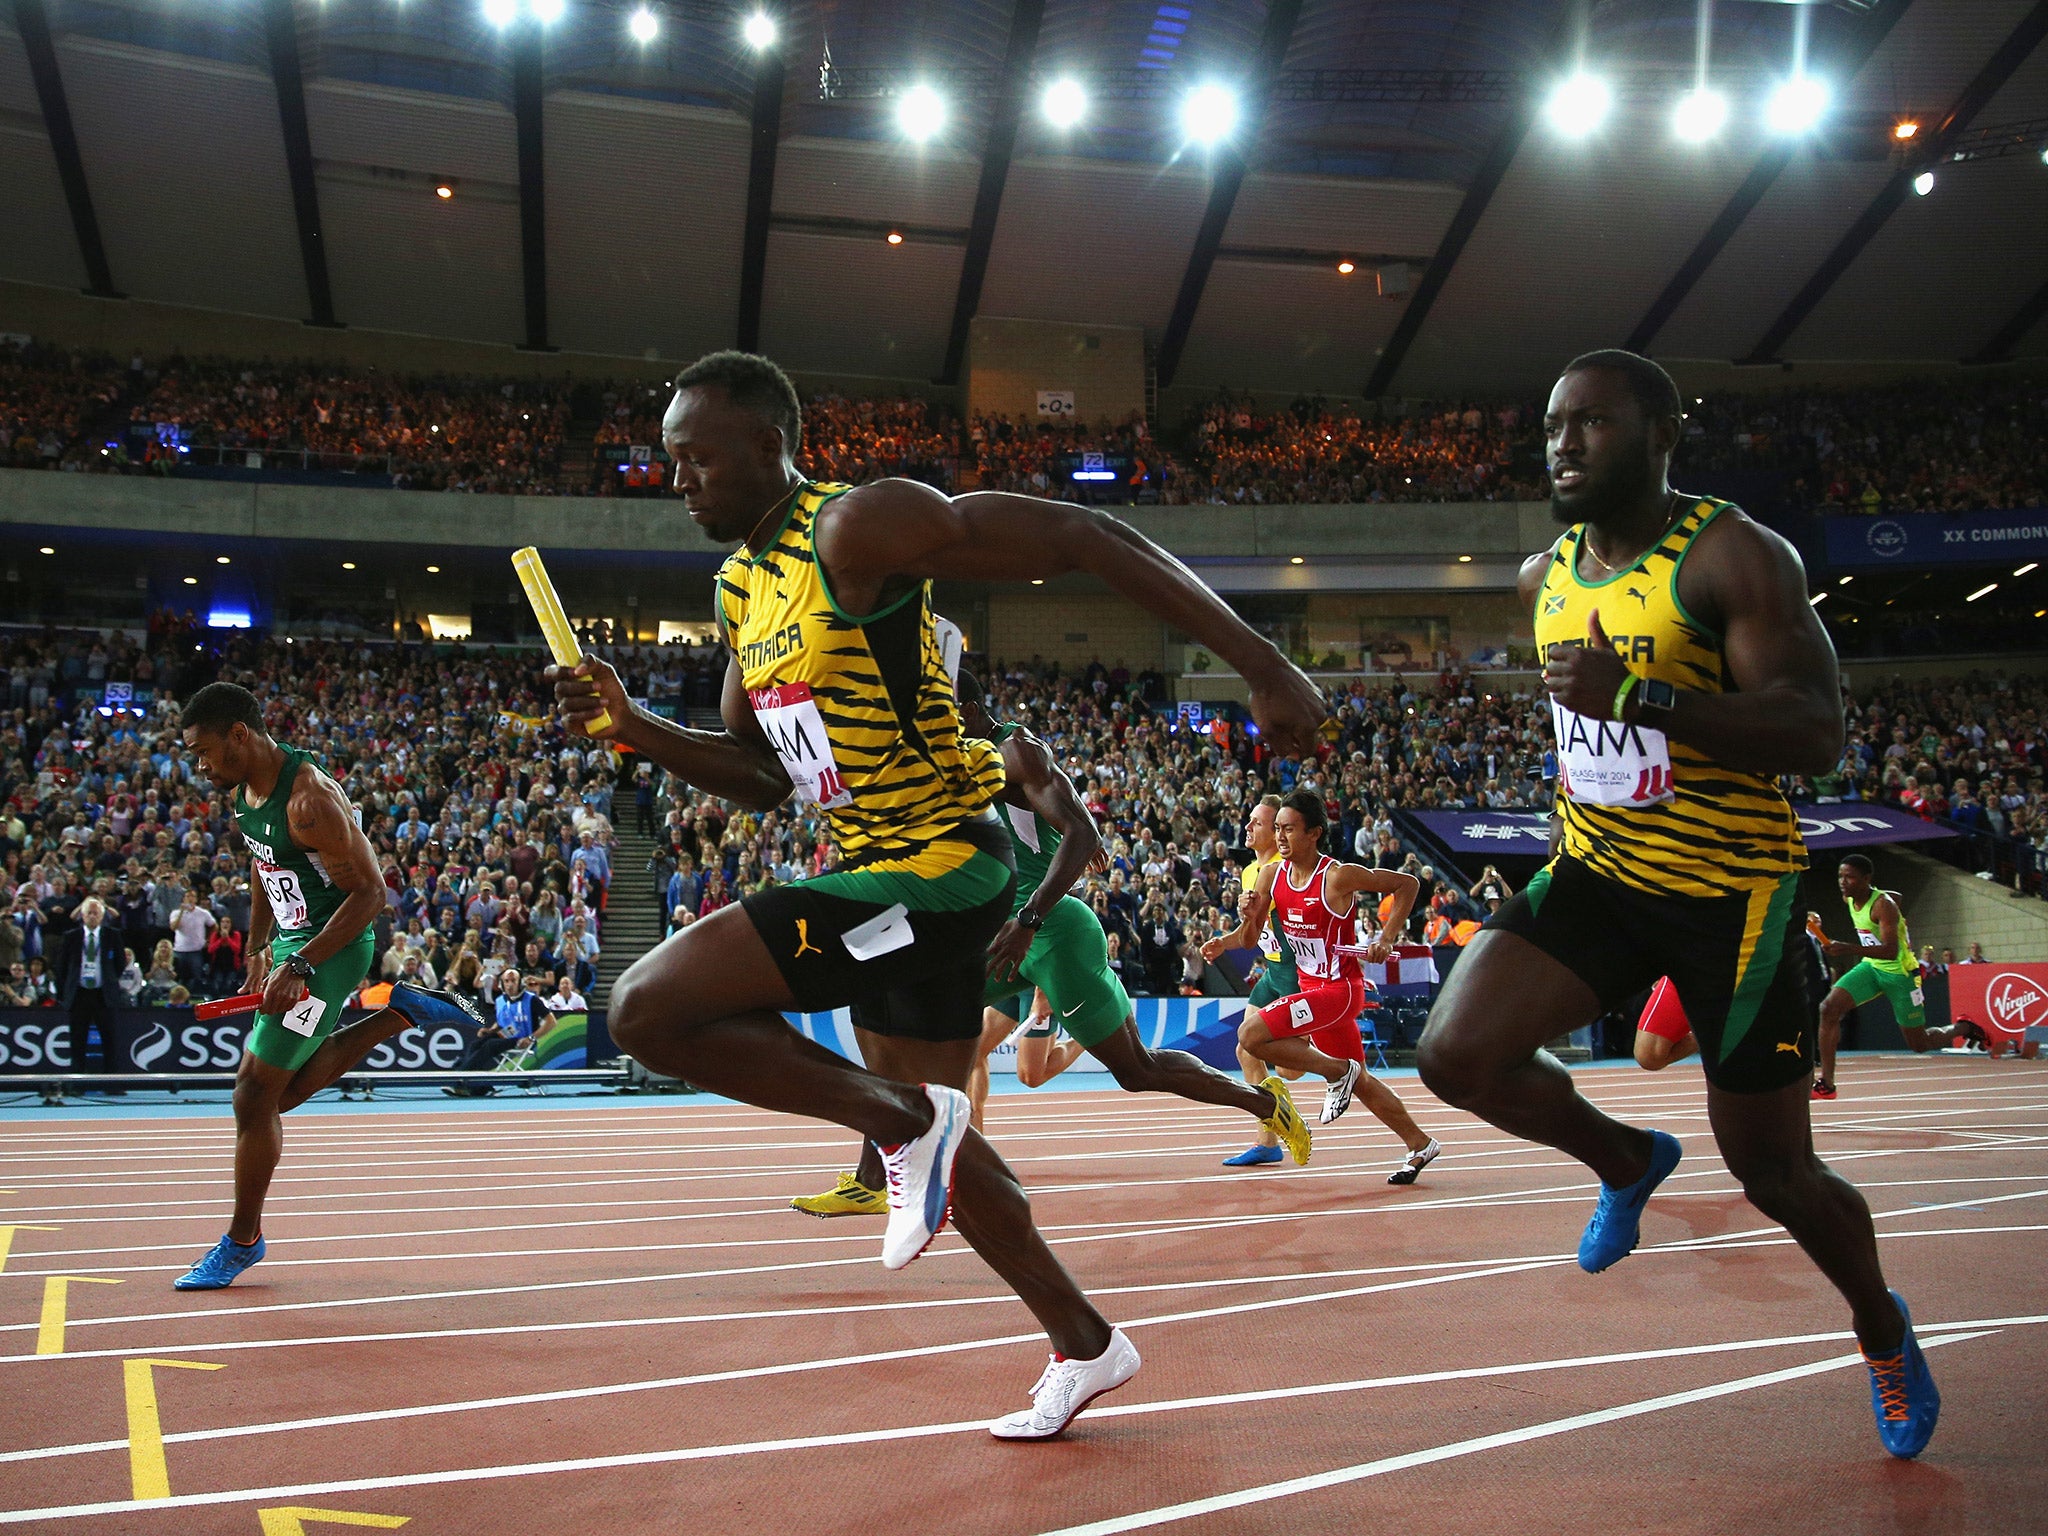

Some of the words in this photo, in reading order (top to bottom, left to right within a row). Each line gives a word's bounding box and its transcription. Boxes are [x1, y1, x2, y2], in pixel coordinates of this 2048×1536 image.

[1049, 399, 1063, 413] Q
[633, 447, 648, 460] 71
[1086, 454, 1102, 466] 72
[1943, 530, 1966, 543] XX
[740, 621, 804, 670] AMAICA
[107, 684, 130, 699] 53
[1180, 703, 1200, 717] 55
[766, 715, 818, 763] AM
[1559, 707, 1647, 758] JAM
[1282, 919, 1318, 931] SINGAPORE
[1287, 937, 1317, 960] SIN
[1994, 983, 2042, 1022] Virgin
[295, 1004, 315, 1027] 4
[1296, 1009, 1308, 1020] 5
